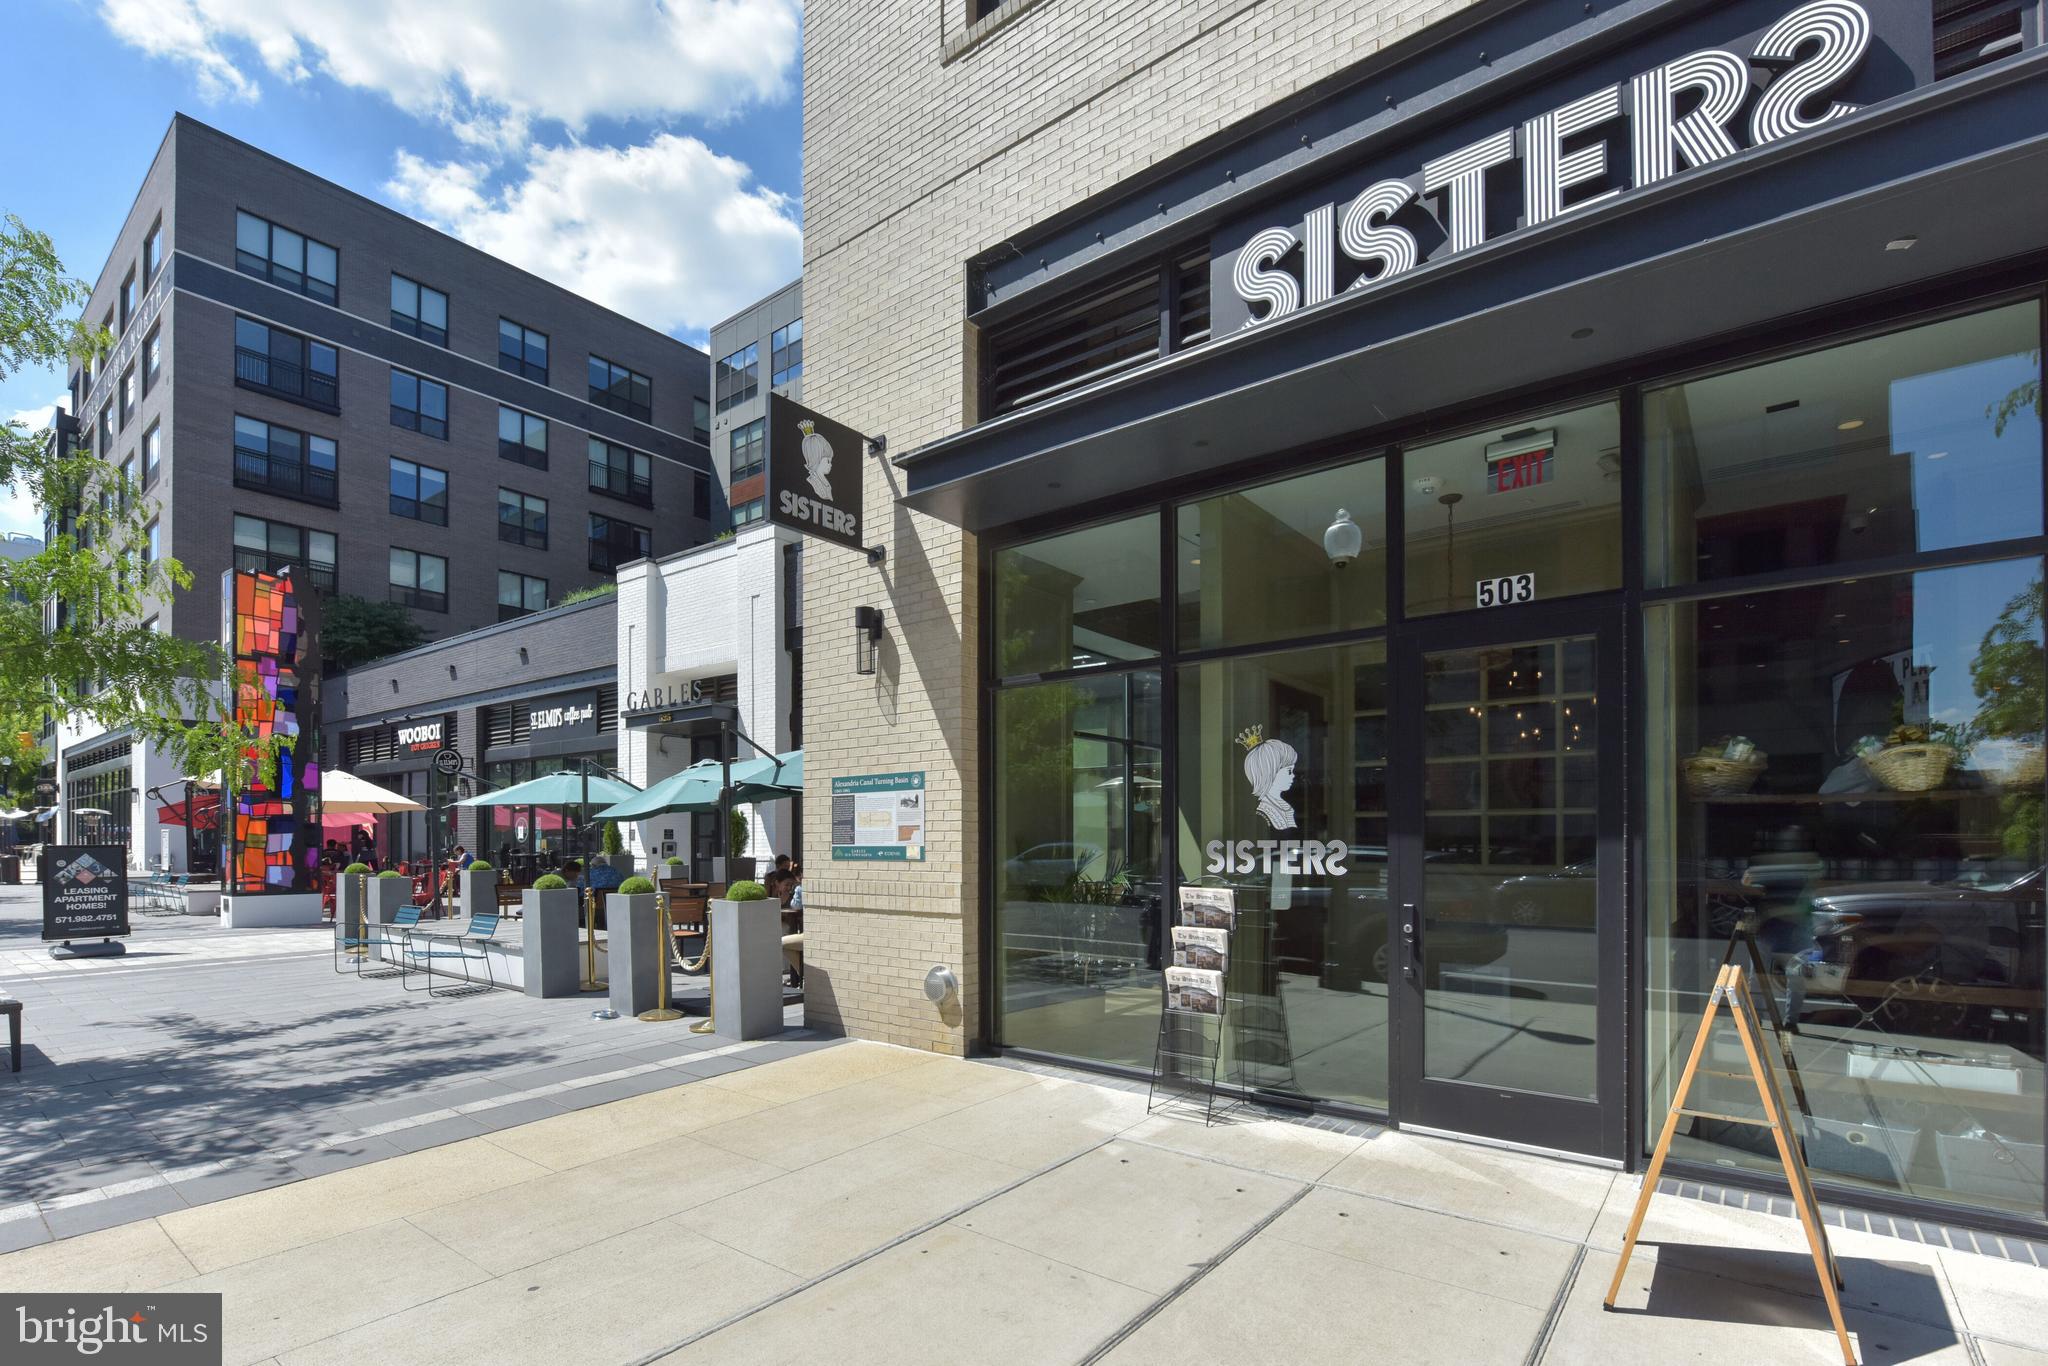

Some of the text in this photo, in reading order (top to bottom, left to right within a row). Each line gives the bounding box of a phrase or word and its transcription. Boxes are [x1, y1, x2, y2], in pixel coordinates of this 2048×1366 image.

[1233, 0, 1871, 331] SISTERS
[1497, 449, 1545, 493] EXIT
[780, 490, 856, 536] SISTERS
[1480, 575, 1532, 606] 503
[627, 680, 702, 711] GABLES
[537, 708, 562, 728] ELMO'S
[564, 706, 580, 725] coffee
[580, 704, 593, 723] pub
[398, 723, 441, 745] WOOBOI
[834, 780, 859, 788] Alexandria
[859, 778, 874, 787] Canal
[894, 776, 909, 784] Basin
[1206, 839, 1348, 876] SISTERS
[54, 894, 118, 903] APARTMENT
[63, 887, 108, 895] LEASING
[66, 902, 107, 910] HOMES!
[55, 914, 117, 924] 571.982.4751
